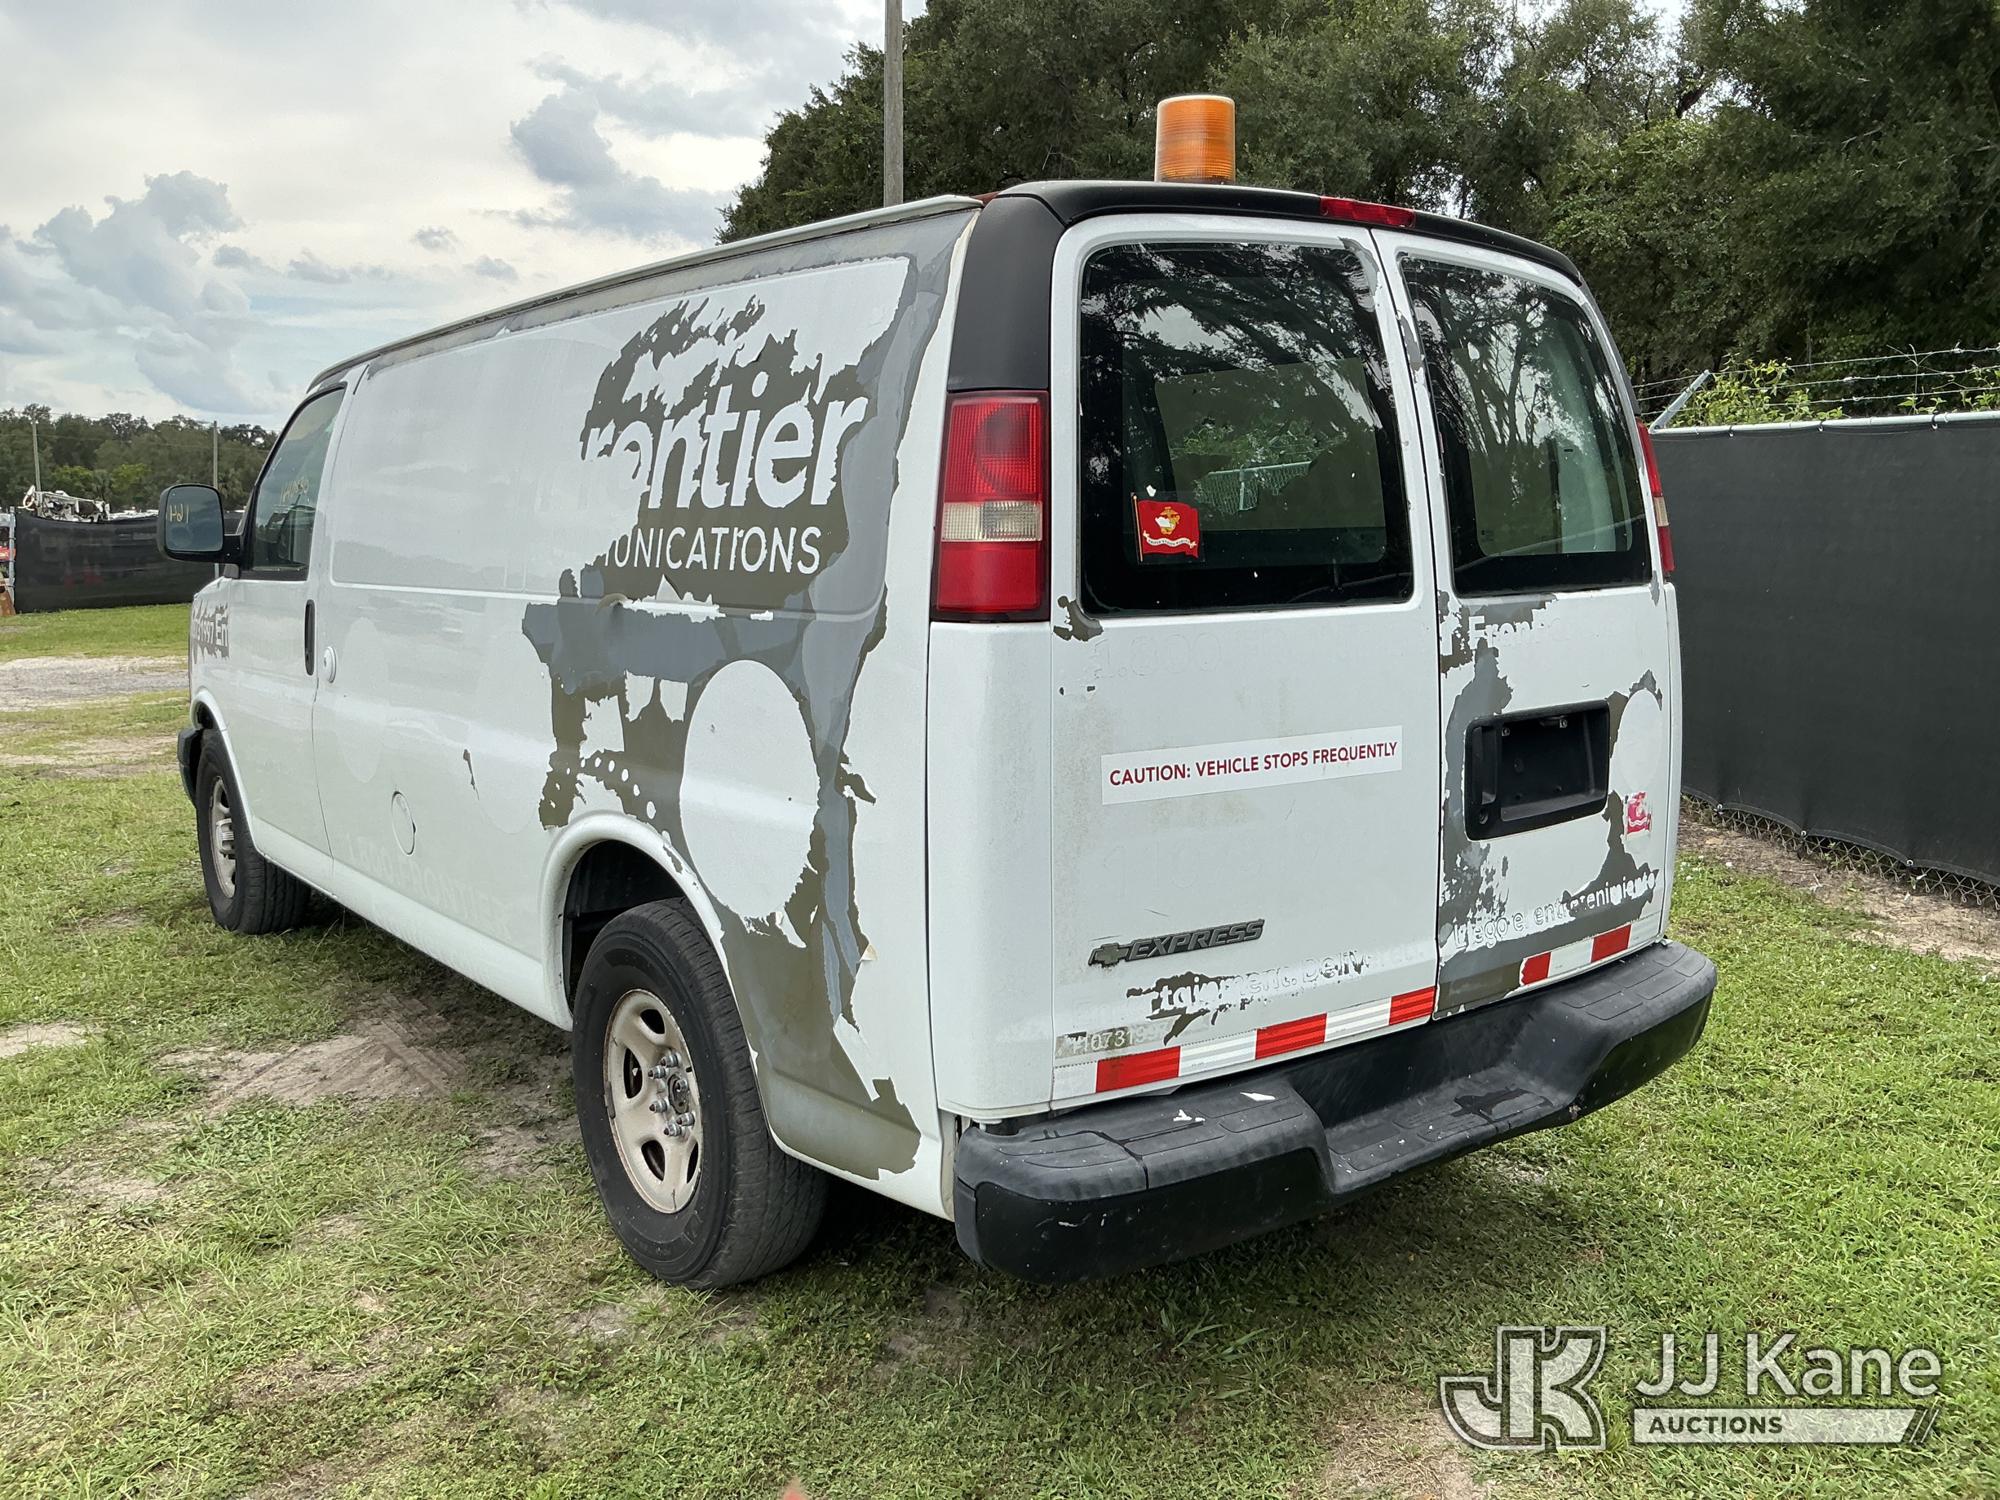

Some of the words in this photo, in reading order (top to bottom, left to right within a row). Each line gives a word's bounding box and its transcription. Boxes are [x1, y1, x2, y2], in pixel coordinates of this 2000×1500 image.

[1109, 763, 1191, 786] CAUTION:
[1195, 756, 1260, 777] VEHICLE
[1263, 750, 1309, 770] STOPS
[1312, 741, 1398, 765] FREQUENTLY
[1128, 919, 1265, 962] EXPRESS
